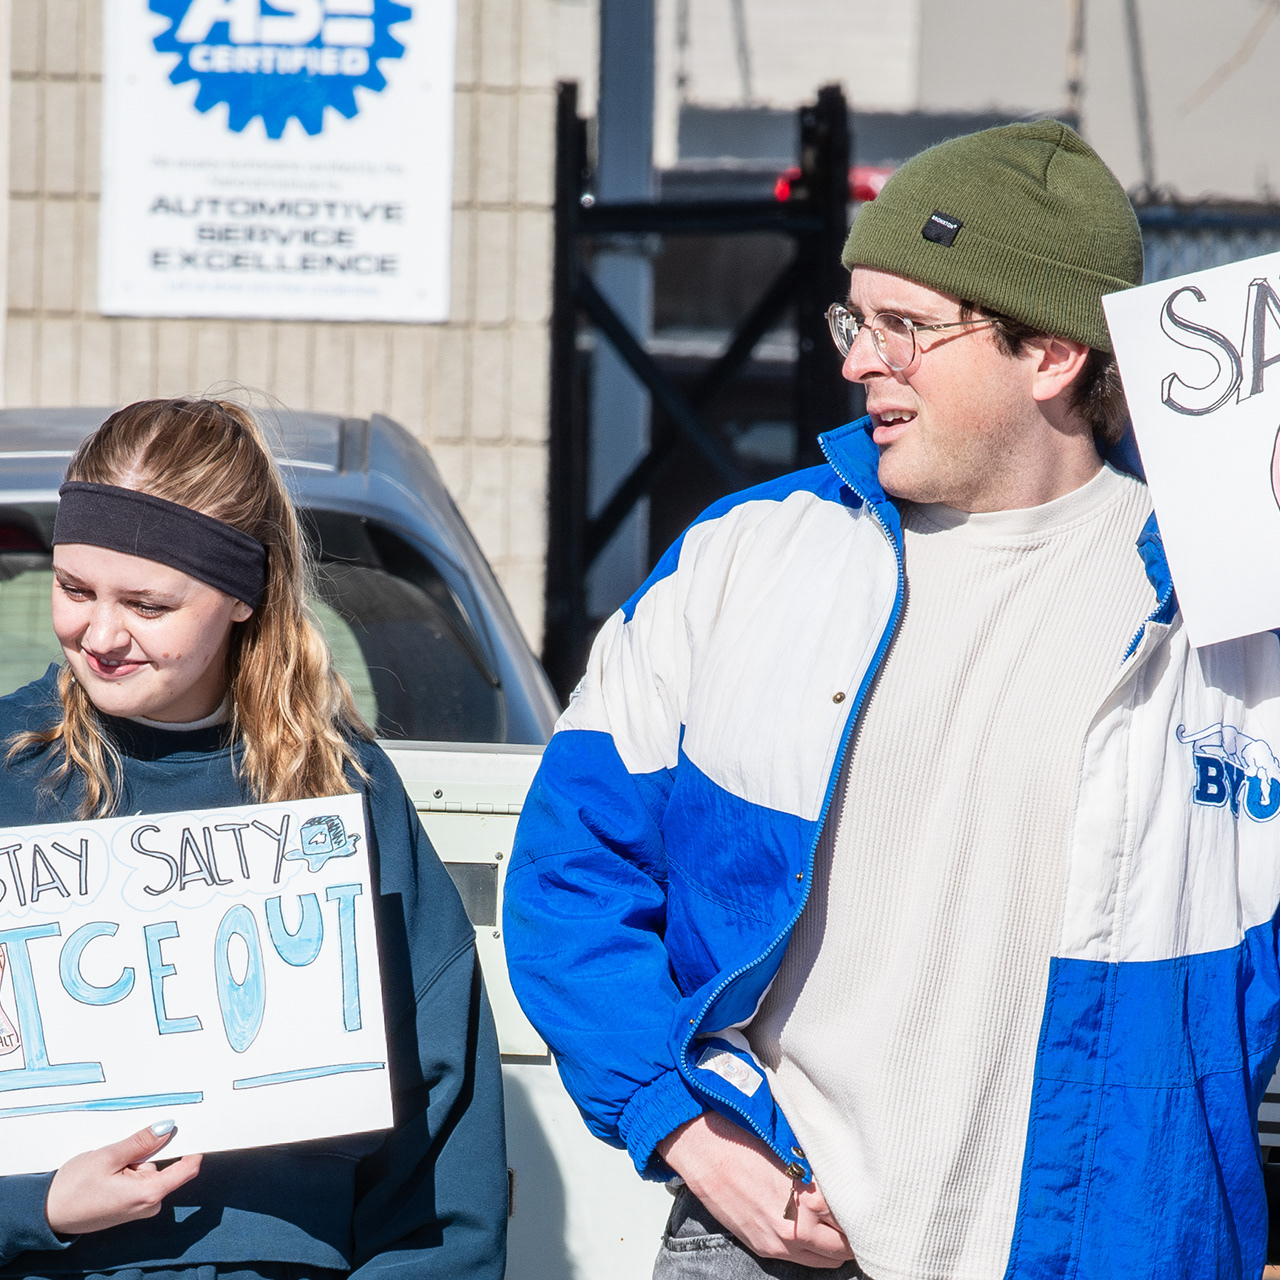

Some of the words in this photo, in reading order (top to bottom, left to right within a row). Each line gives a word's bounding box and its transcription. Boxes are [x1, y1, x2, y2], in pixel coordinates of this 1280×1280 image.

[188, 43, 370, 76] CERTIFIED
[150, 195, 404, 222] AUTOMOTIVE
[196, 223, 356, 247] SERVICE
[151, 249, 400, 275] EXCELLENCE
[130, 814, 291, 896] SALTY
[214, 884, 364, 1053] OUT
